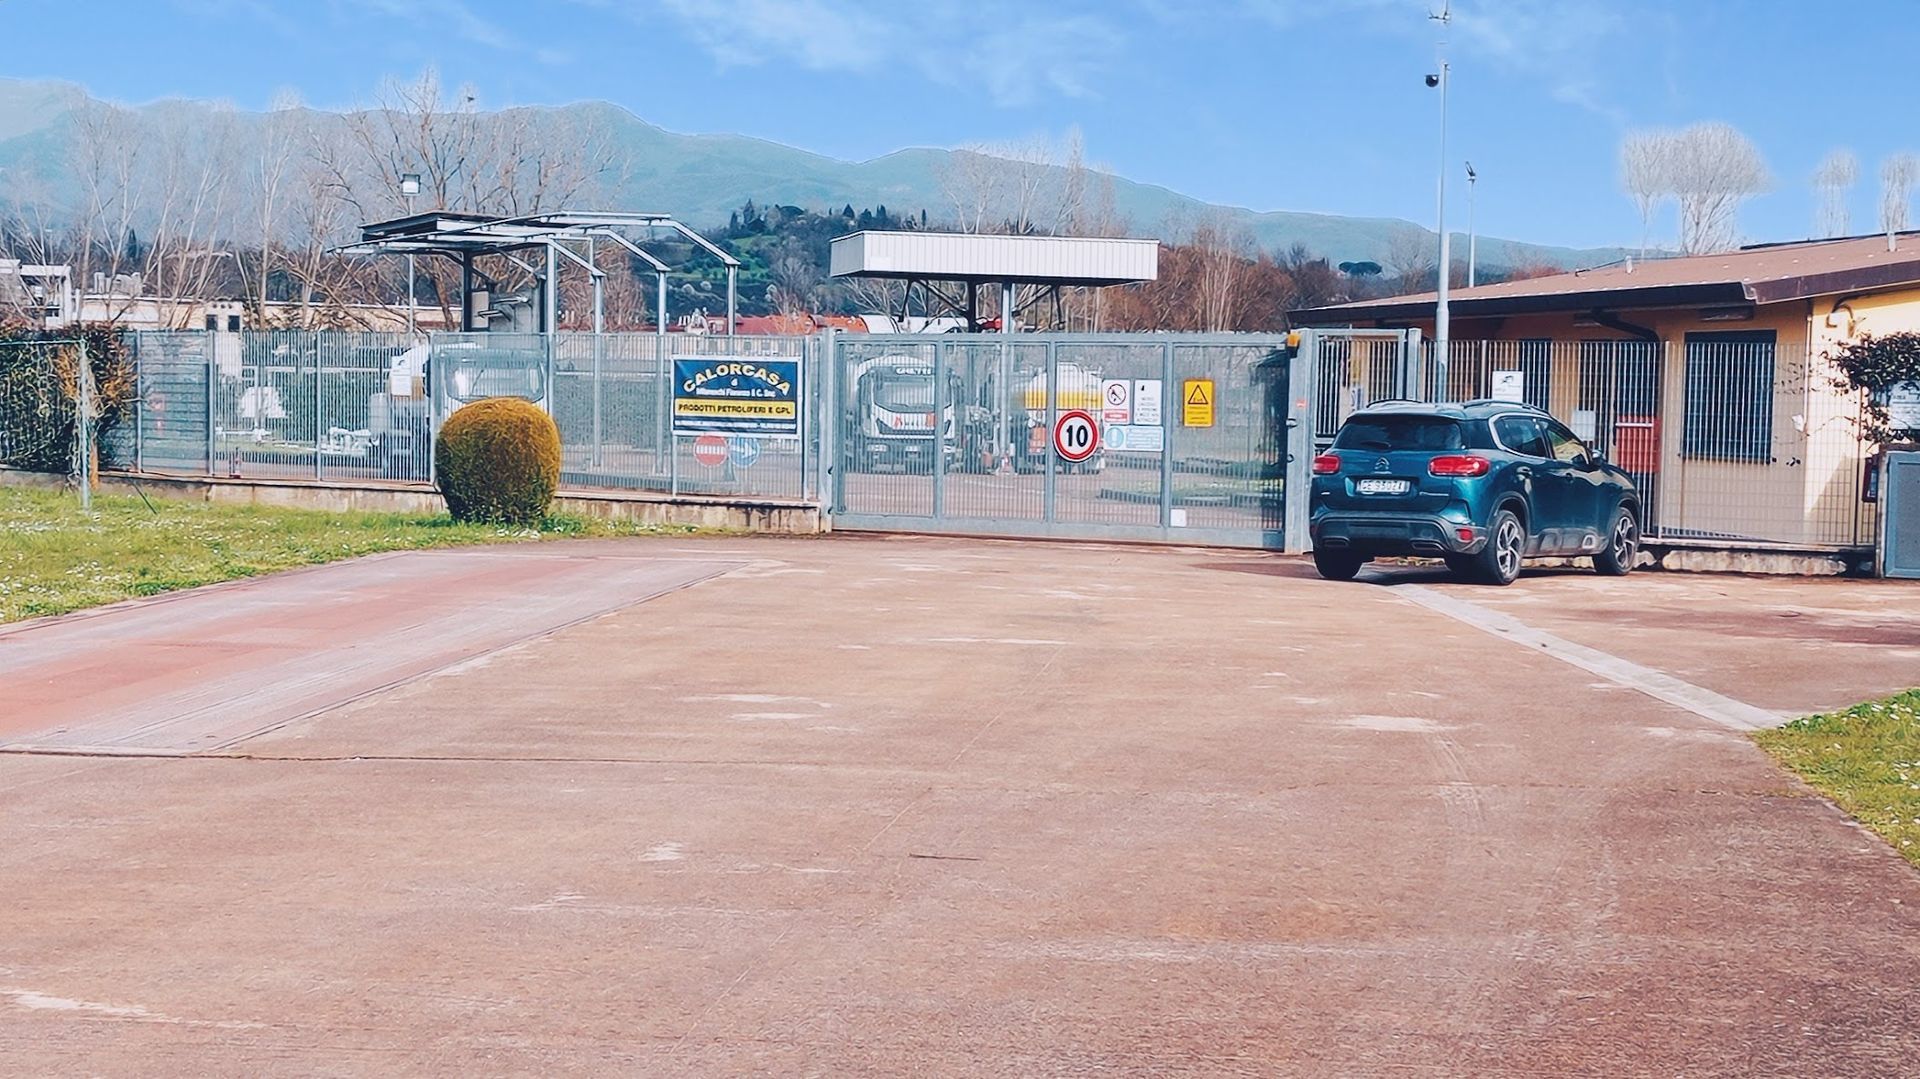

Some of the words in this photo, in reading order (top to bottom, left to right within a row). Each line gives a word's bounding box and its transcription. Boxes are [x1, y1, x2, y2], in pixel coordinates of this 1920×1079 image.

[683, 363, 790, 396] CALORCASA
[678, 403, 716, 413] PRODOTTI
[717, 405, 766, 414] PETROLIFERI
[775, 406, 791, 414] GPL
[1066, 425, 1088, 447] 10
